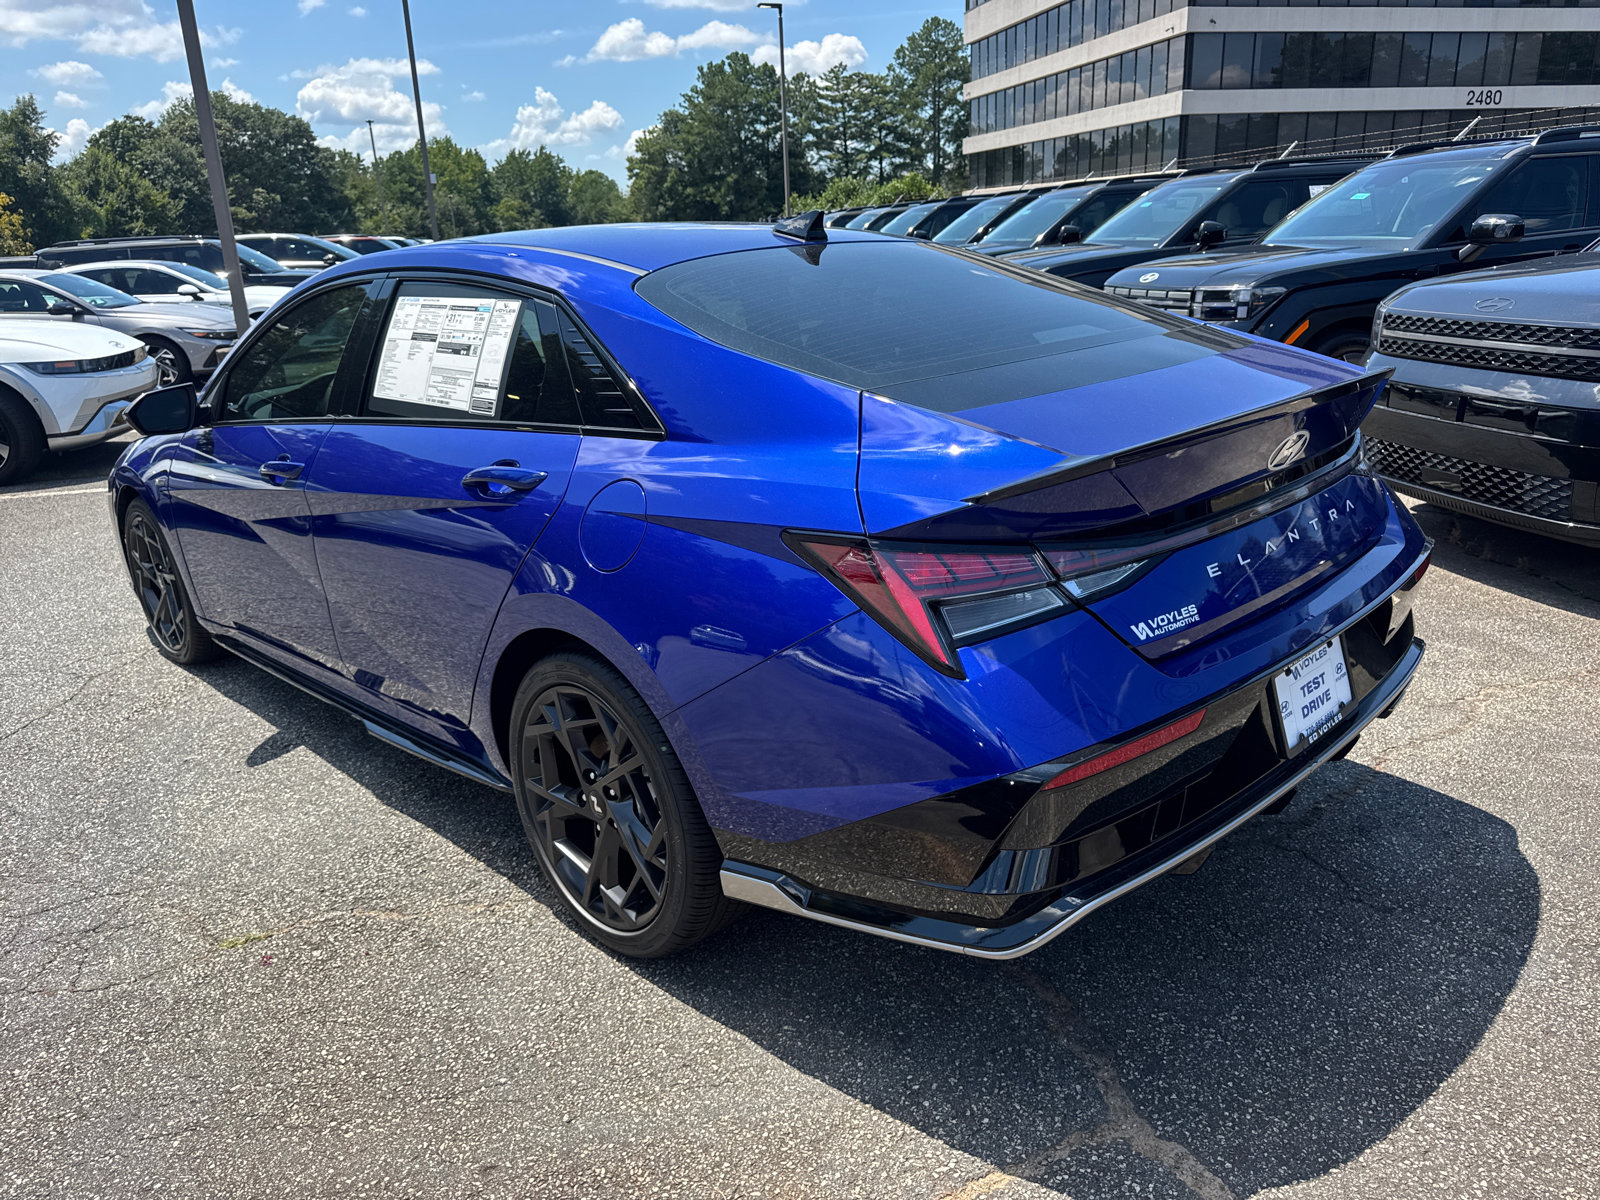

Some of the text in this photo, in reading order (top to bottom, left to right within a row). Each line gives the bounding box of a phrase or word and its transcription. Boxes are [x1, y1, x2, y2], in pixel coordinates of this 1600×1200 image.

[1466, 89, 1503, 106] 2480
[1206, 499, 1355, 578] ELANTRA
[1148, 604, 1198, 628] VOYLES
[1154, 614, 1200, 636] AUTOMOTIVE
[1299, 646, 1328, 671] VOYLES
[1300, 672, 1326, 698] TEST
[1301, 688, 1332, 719] DRIVE
[1308, 712, 1343, 744] ED VOYLES
